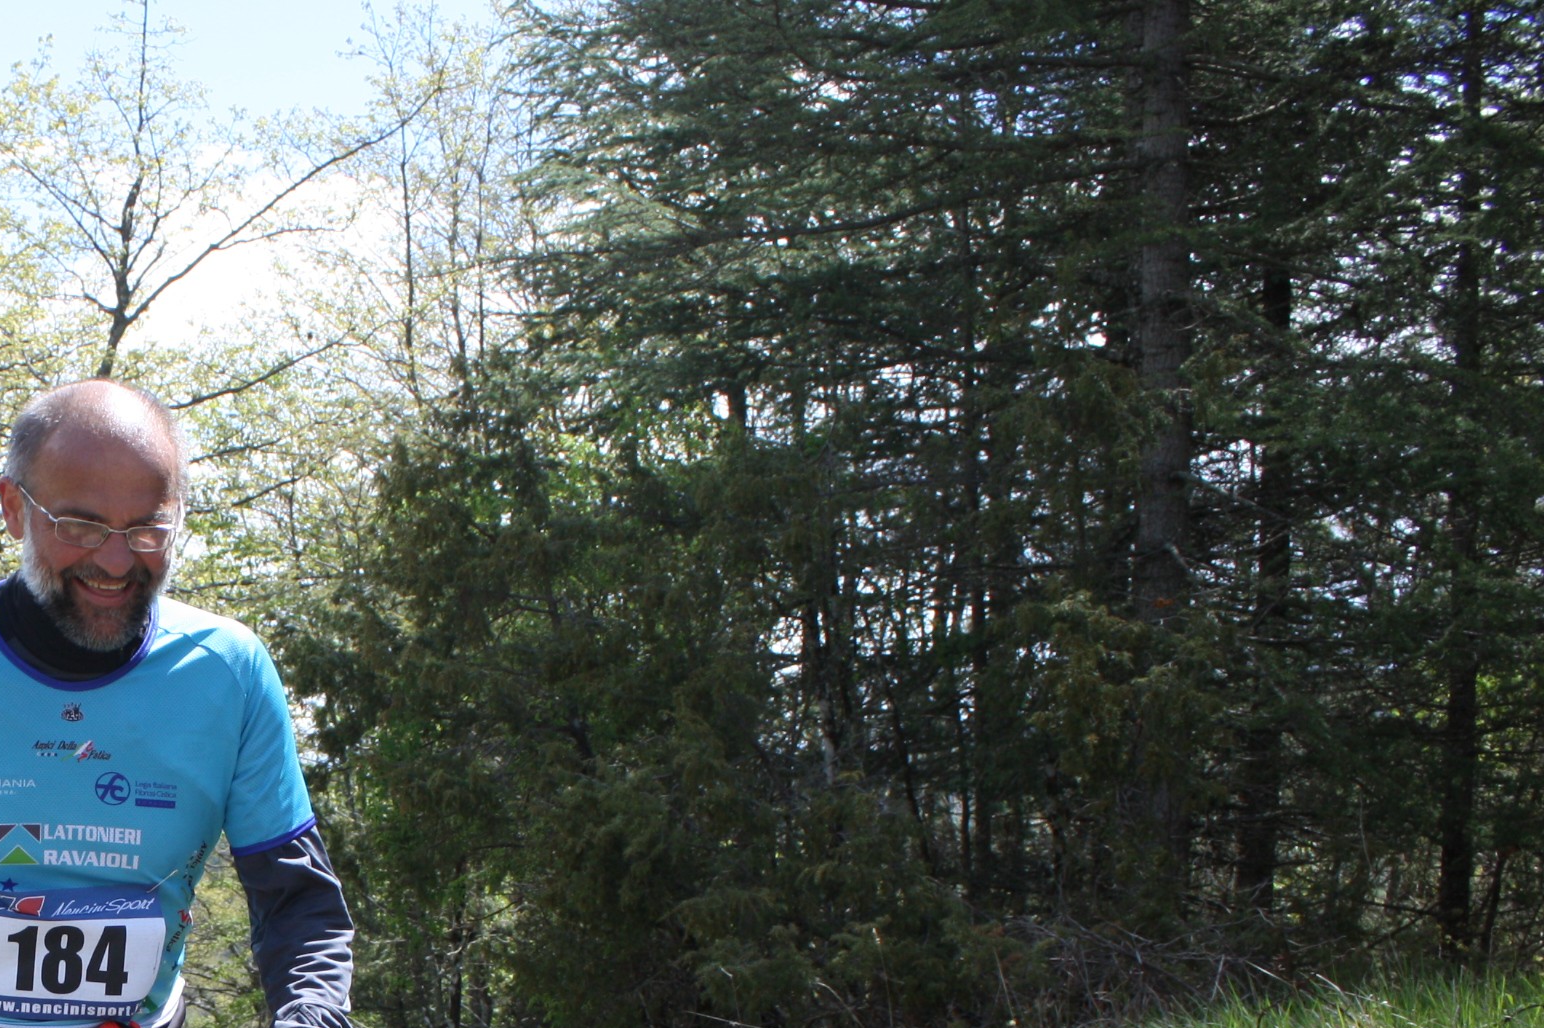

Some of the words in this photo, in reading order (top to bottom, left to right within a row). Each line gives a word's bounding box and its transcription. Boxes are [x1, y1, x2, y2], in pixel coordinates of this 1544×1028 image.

[44, 824, 142, 845] LATTONIERI
[43, 850, 140, 870] RAVAIOLI
[8, 925, 128, 996] 184
